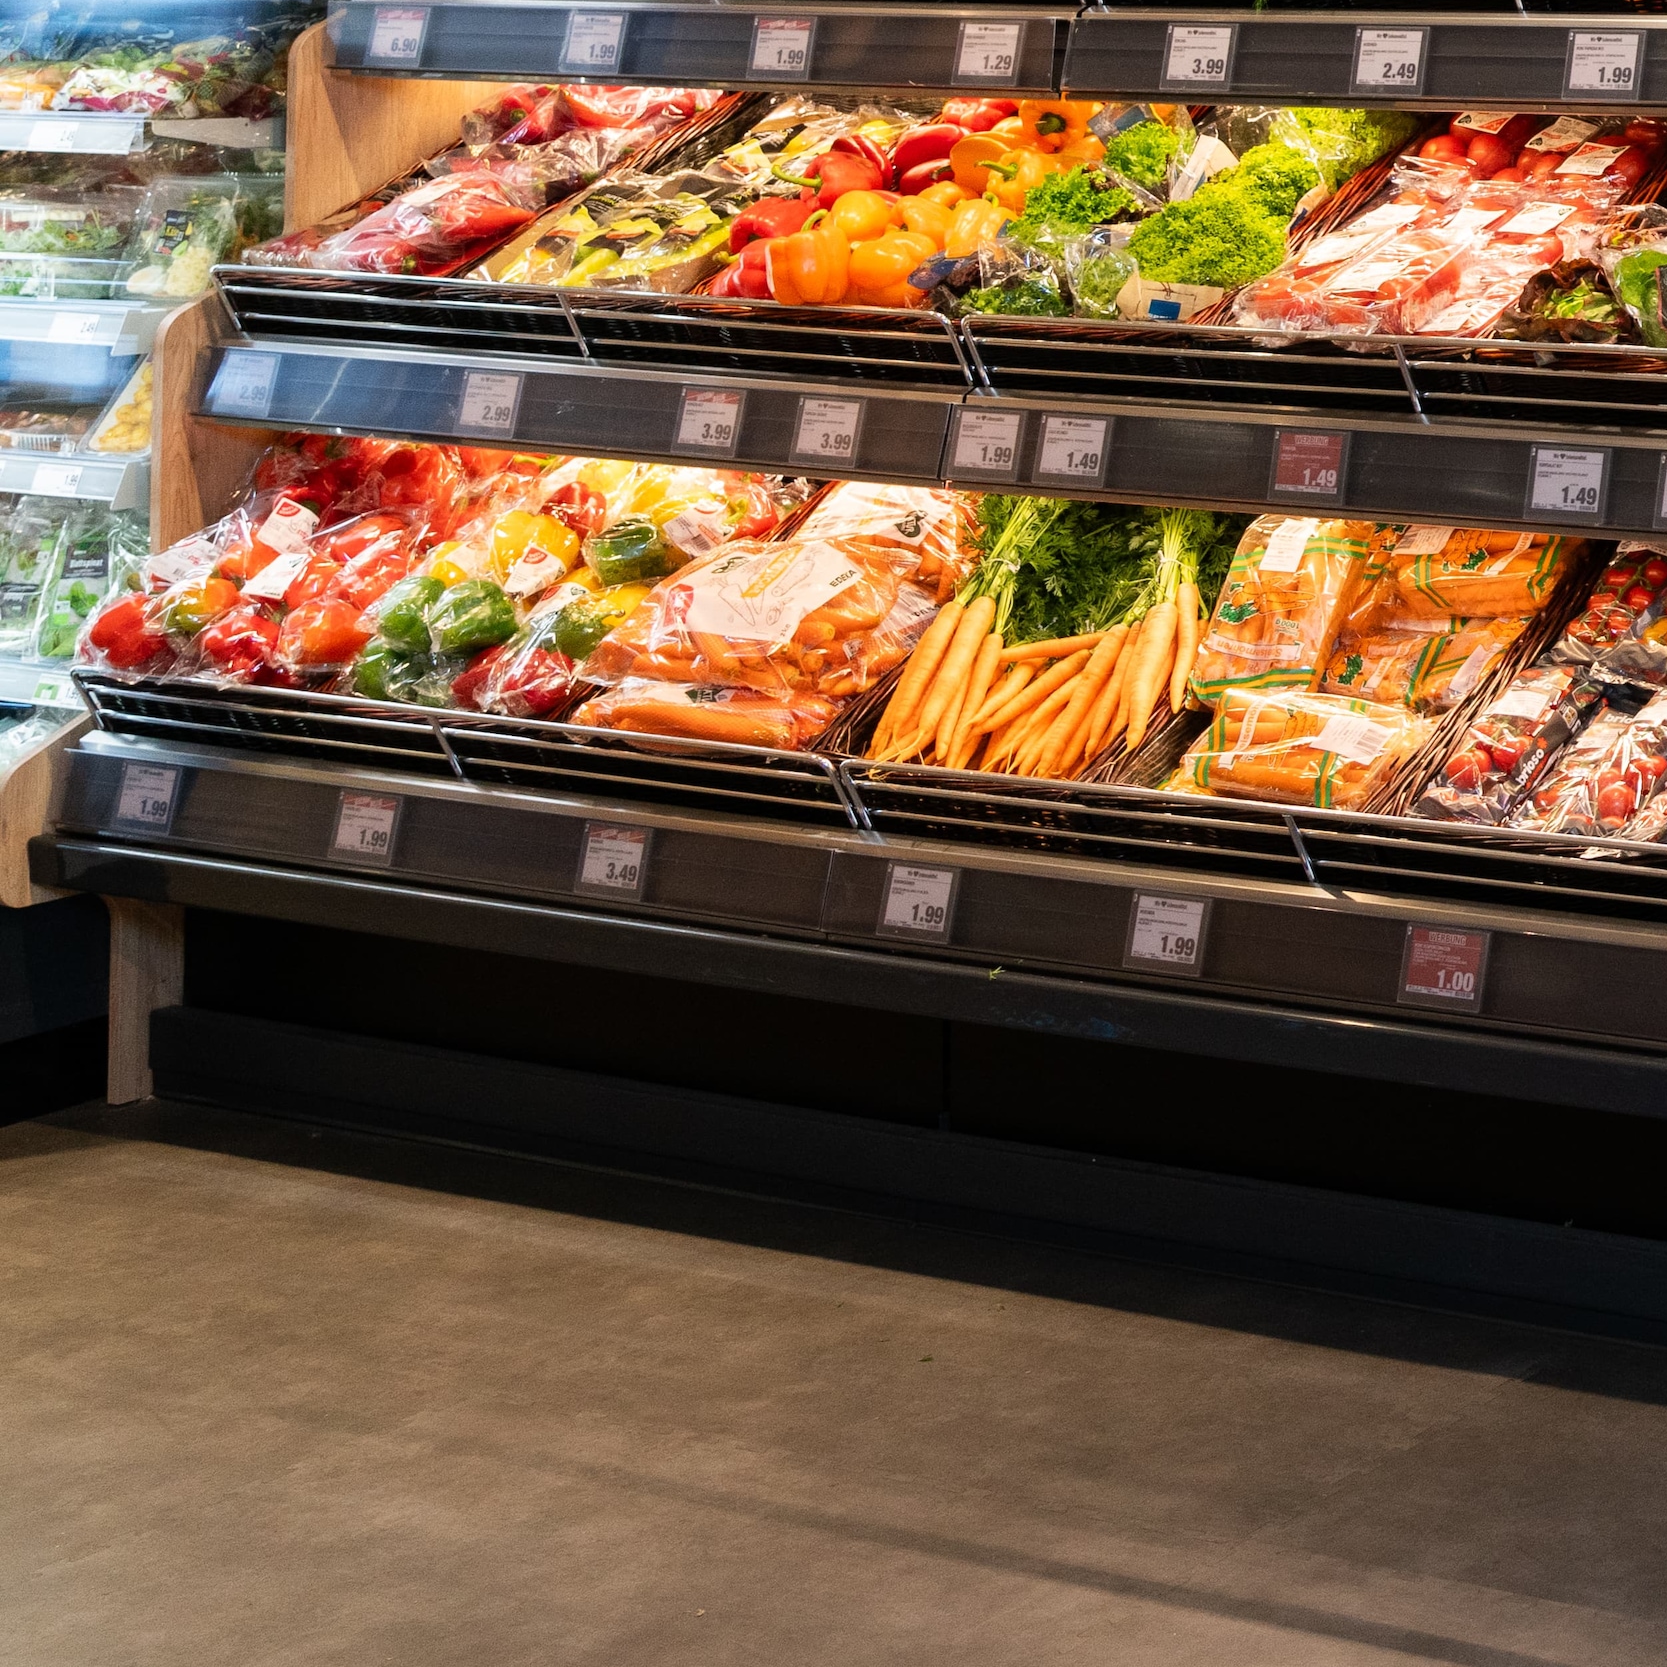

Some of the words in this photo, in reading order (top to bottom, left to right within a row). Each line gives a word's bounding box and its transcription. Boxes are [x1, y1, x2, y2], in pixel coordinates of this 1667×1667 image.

[391, 38, 417, 52] 6.90
[589, 44, 615, 59] 1.99
[777, 49, 804, 64] 1.99
[983, 55, 1012, 70] 1.29
[1192, 58, 1224, 74] 3.99
[1382, 63, 1416, 79] 2.49
[1598, 67, 1632, 83] 1.99
[482, 405, 510, 422] 2.99
[702, 423, 731, 440] 3.99
[820, 433, 851, 450] 3.99
[981, 446, 1012, 463] 1.99
[1067, 452, 1098, 469] 1.49
[1303, 468, 1337, 486] 1.49
[1562, 486, 1597, 505] 1.49
[829, 570, 857, 588] EDEKA
[1603, 713, 1634, 724] brio
[1515, 748, 1545, 786] brioso
[141, 799, 168, 817] 1.99
[360, 828, 387, 847] 1.99
[606, 862, 637, 882] 3.49
[912, 904, 944, 924] 1.99
[1161, 935, 1195, 957] 1.99
[1429, 932, 1467, 946] WERBUNG
[1437, 969, 1474, 992] 1.00
